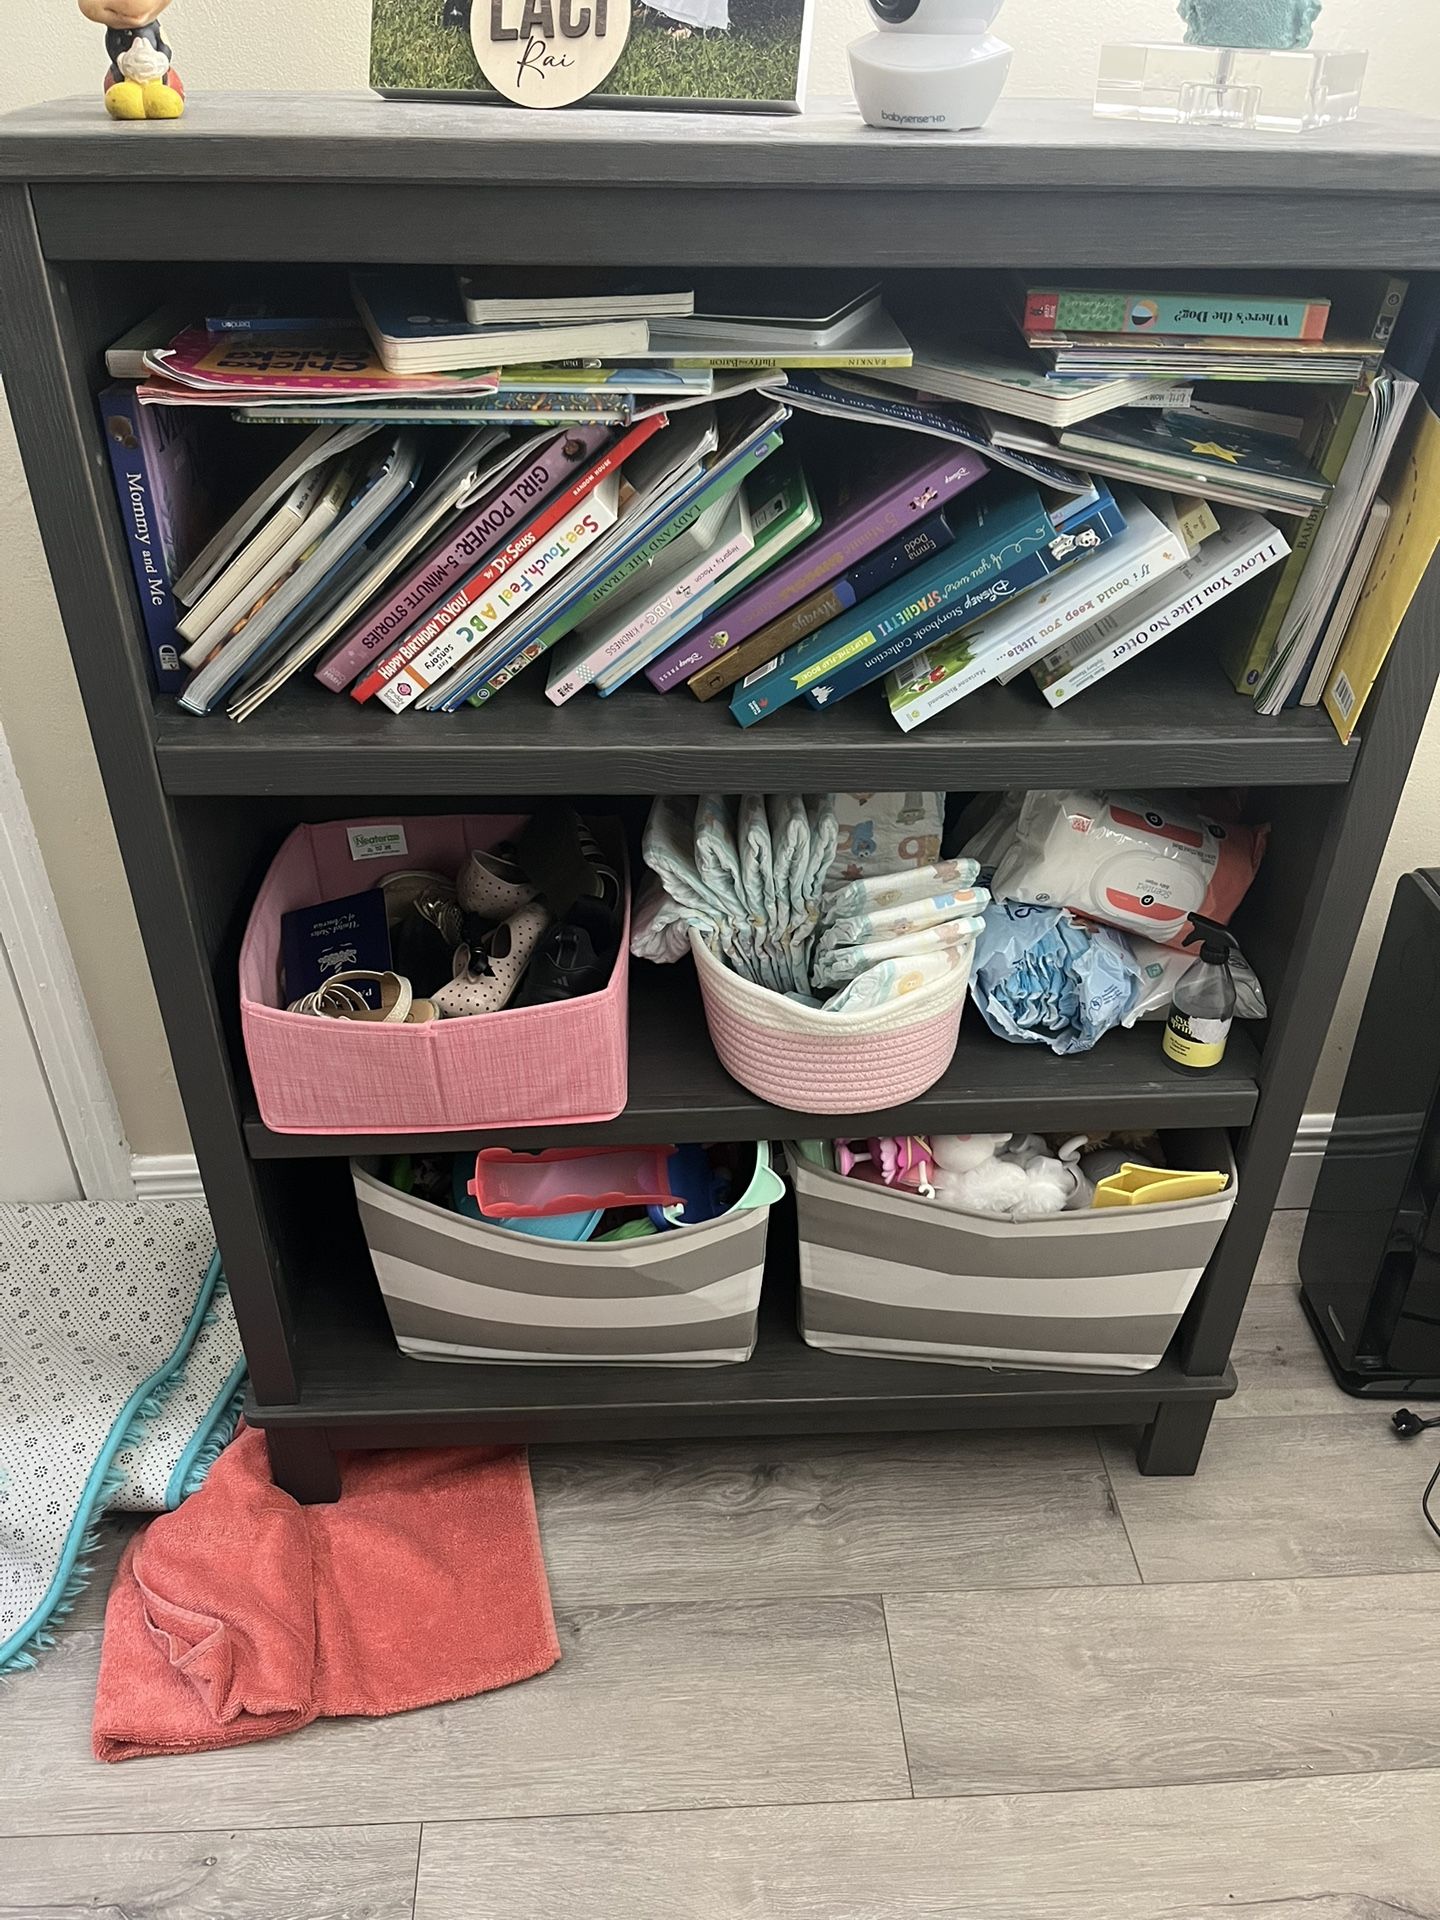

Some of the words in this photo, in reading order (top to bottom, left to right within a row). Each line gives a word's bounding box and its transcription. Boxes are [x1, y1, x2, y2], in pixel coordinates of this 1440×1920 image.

[490, 0, 608, 41] LACI
[516, 35, 575, 88] Rai
[881, 110, 929, 125] babysense
[1173, 308, 1208, 323] Dog?
[1212, 311, 1233, 324] the
[1237, 312, 1289, 327] Where's
[216, 360, 368, 372] Chicka
[572, 475, 595, 496] RANDOM
[594, 458, 612, 477] HOUSE
[126, 472, 151, 545] Mommy
[672, 504, 702, 530] LADY
[649, 527, 673, 551] AND
[903, 532, 930, 554] Dodd
[907, 538, 938, 561] Emma
[1268, 544, 1278, 557] I
[142, 549, 157, 573] and
[627, 550, 651, 570] THE
[969, 559, 992, 578] you
[1231, 552, 1269, 576] Love
[148, 578, 165, 606] Me
[592, 571, 627, 601] TRAMP
[1202, 575, 1233, 596] You
[792, 599, 837, 632] Always
[877, 590, 943, 637] SPAGHETTI
[1064, 600, 1096, 623] keep
[1170, 594, 1204, 619] Like
[456, 602, 498, 643] ABC
[915, 606, 963, 639] Storybook
[1039, 620, 1063, 638] you
[1149, 614, 1173, 633] No
[605, 626, 640, 656] KINDNESS
[865, 635, 913, 668] Collection
[1111, 630, 1150, 660] Otter
[378, 657, 405, 680] HAPPY
[424, 643, 455, 671] sensory
